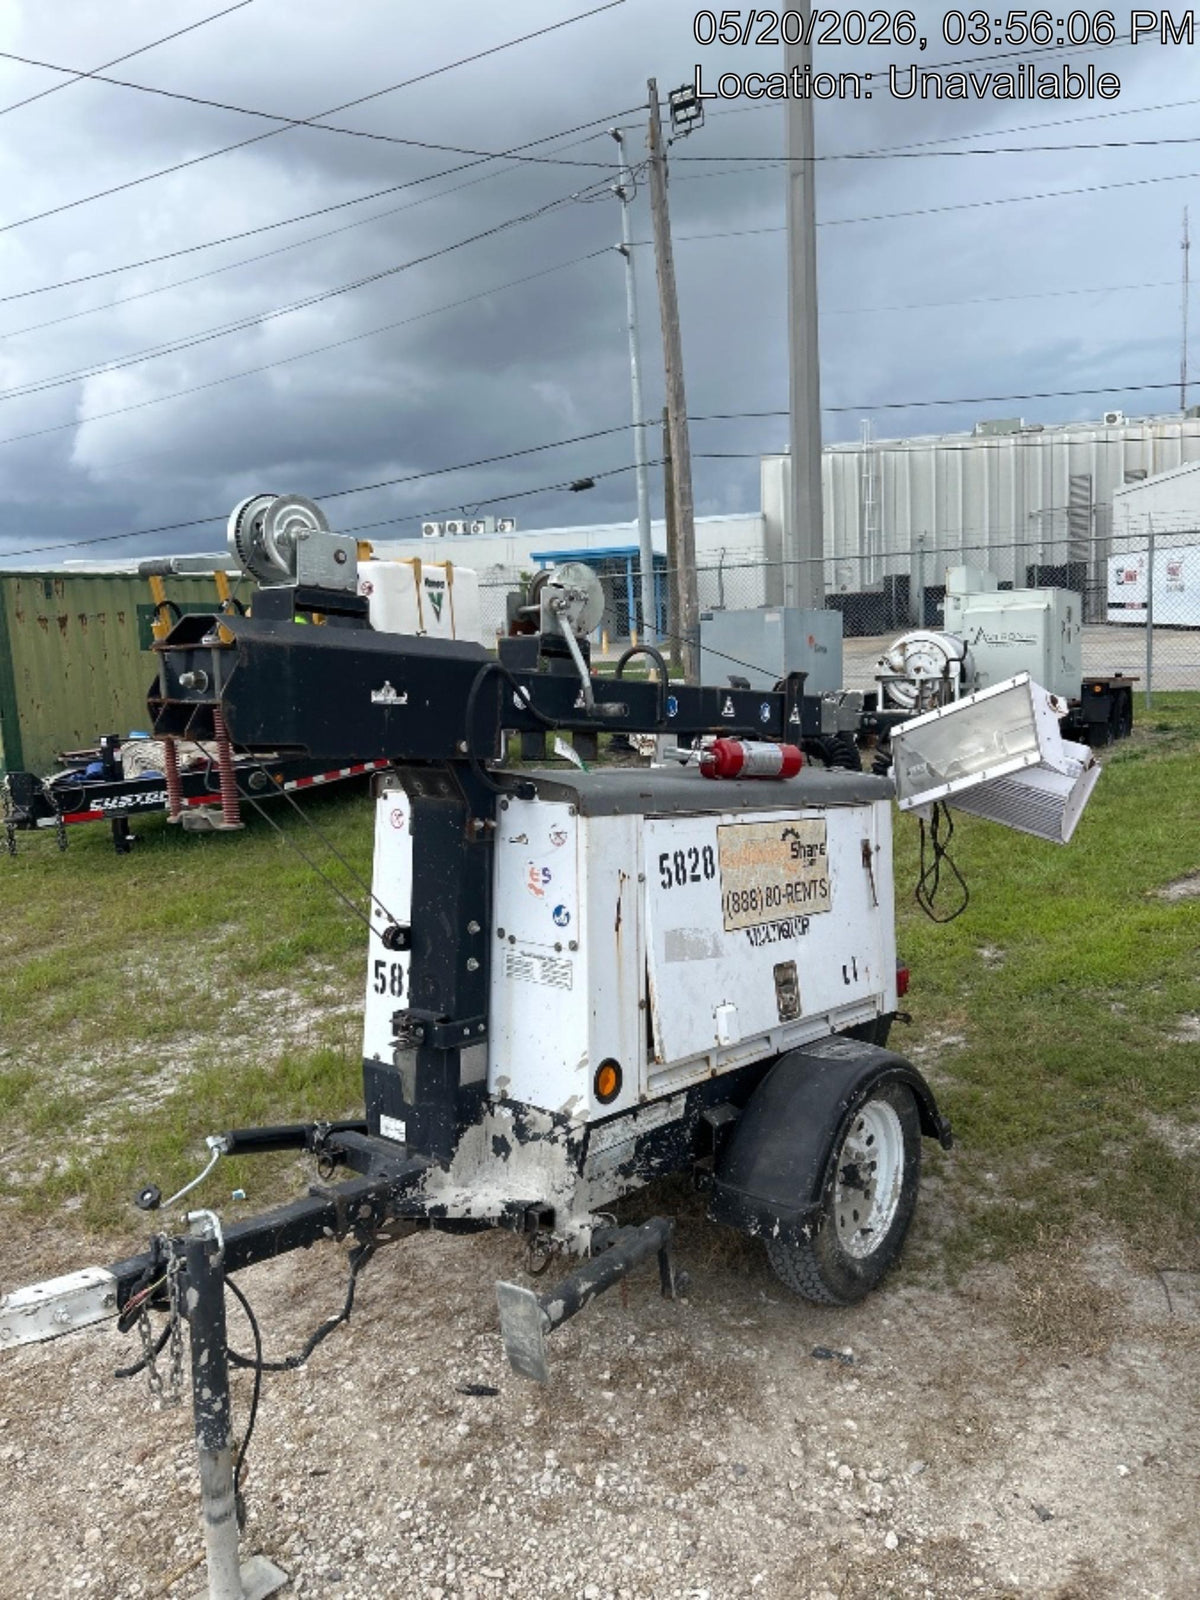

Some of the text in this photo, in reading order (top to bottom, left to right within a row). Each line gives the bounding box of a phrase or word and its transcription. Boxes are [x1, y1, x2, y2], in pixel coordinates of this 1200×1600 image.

[659, 846, 715, 889] 5828
[790, 841, 826, 859] Share
[726, 886, 763, 919] (888)
[374, 959, 411, 998] 58
